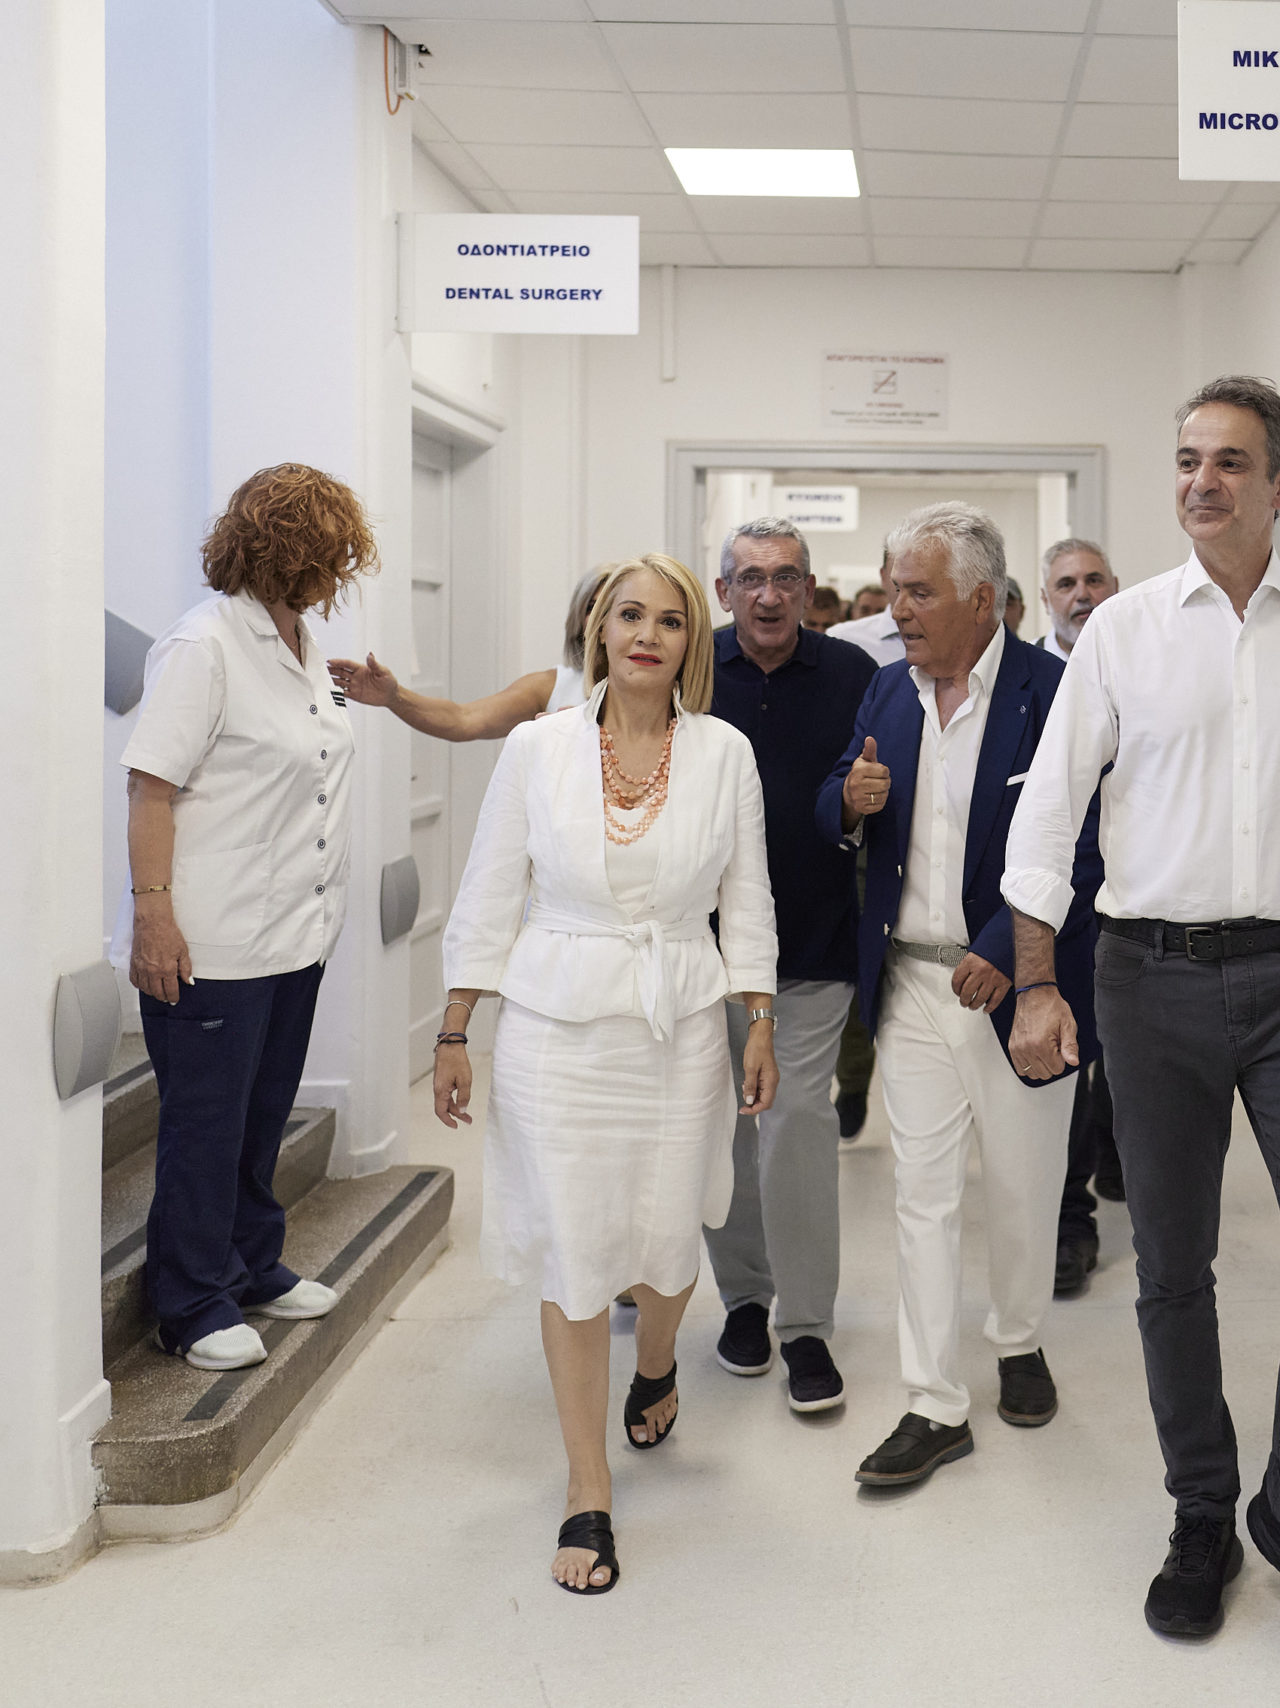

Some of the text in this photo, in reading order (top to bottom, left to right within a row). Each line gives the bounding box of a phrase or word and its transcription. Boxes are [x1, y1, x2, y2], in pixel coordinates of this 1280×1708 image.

[457, 244, 590, 257] ΟΔΟΝΤΙΑΤΡΕΙΟ
[445, 287, 602, 301] DENTAL SURGERY
